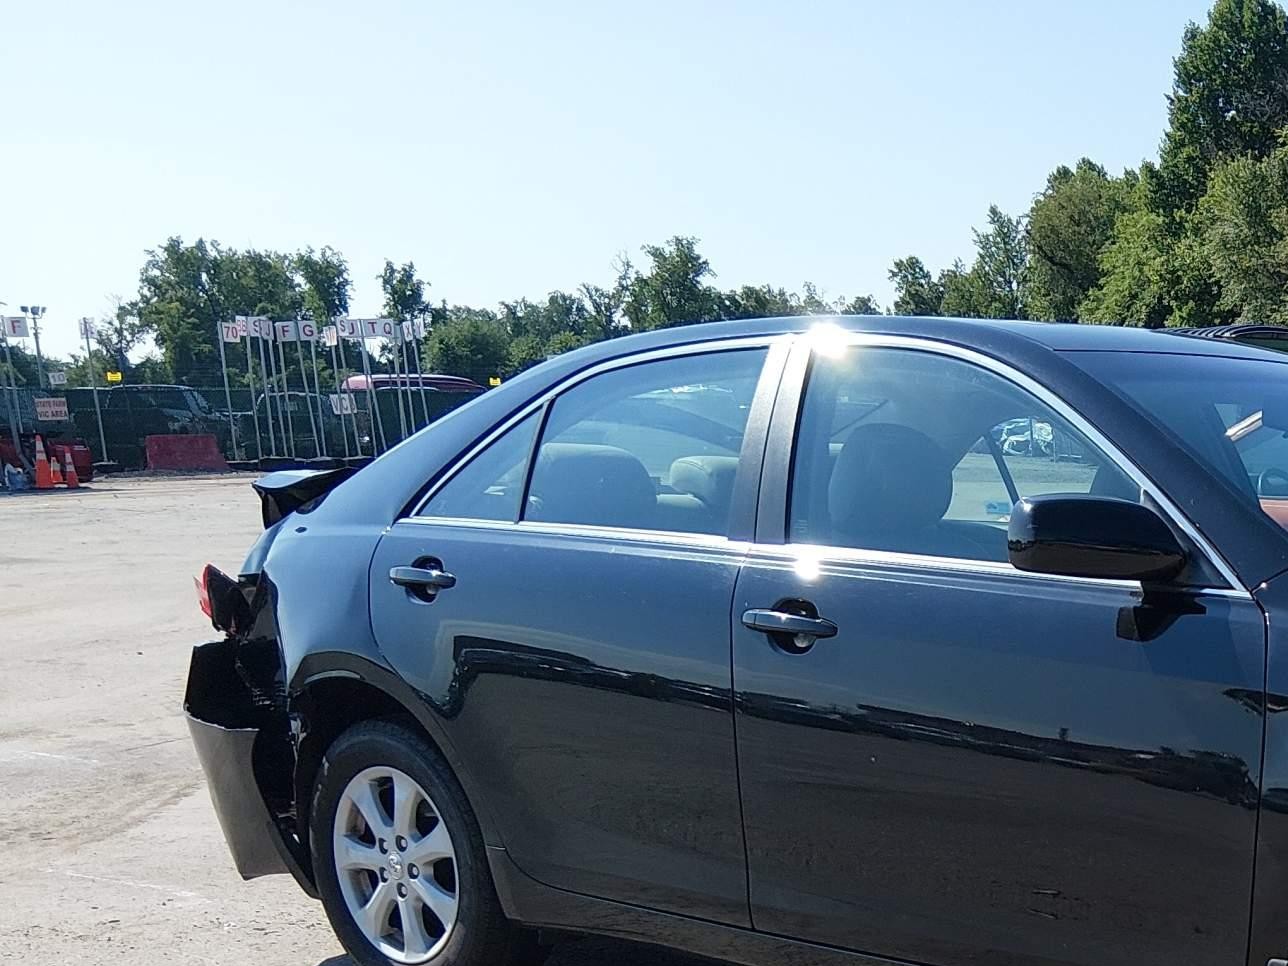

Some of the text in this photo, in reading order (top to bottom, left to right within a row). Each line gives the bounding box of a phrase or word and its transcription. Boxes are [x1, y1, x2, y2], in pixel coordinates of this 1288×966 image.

[11, 320, 21, 334] F
[224, 325, 238, 339] 70
[281, 325, 289, 337] F
[302, 324, 314, 336] G
[348, 322, 355, 335] J
[367, 322, 377, 334] T
[383, 322, 393, 335] Q
